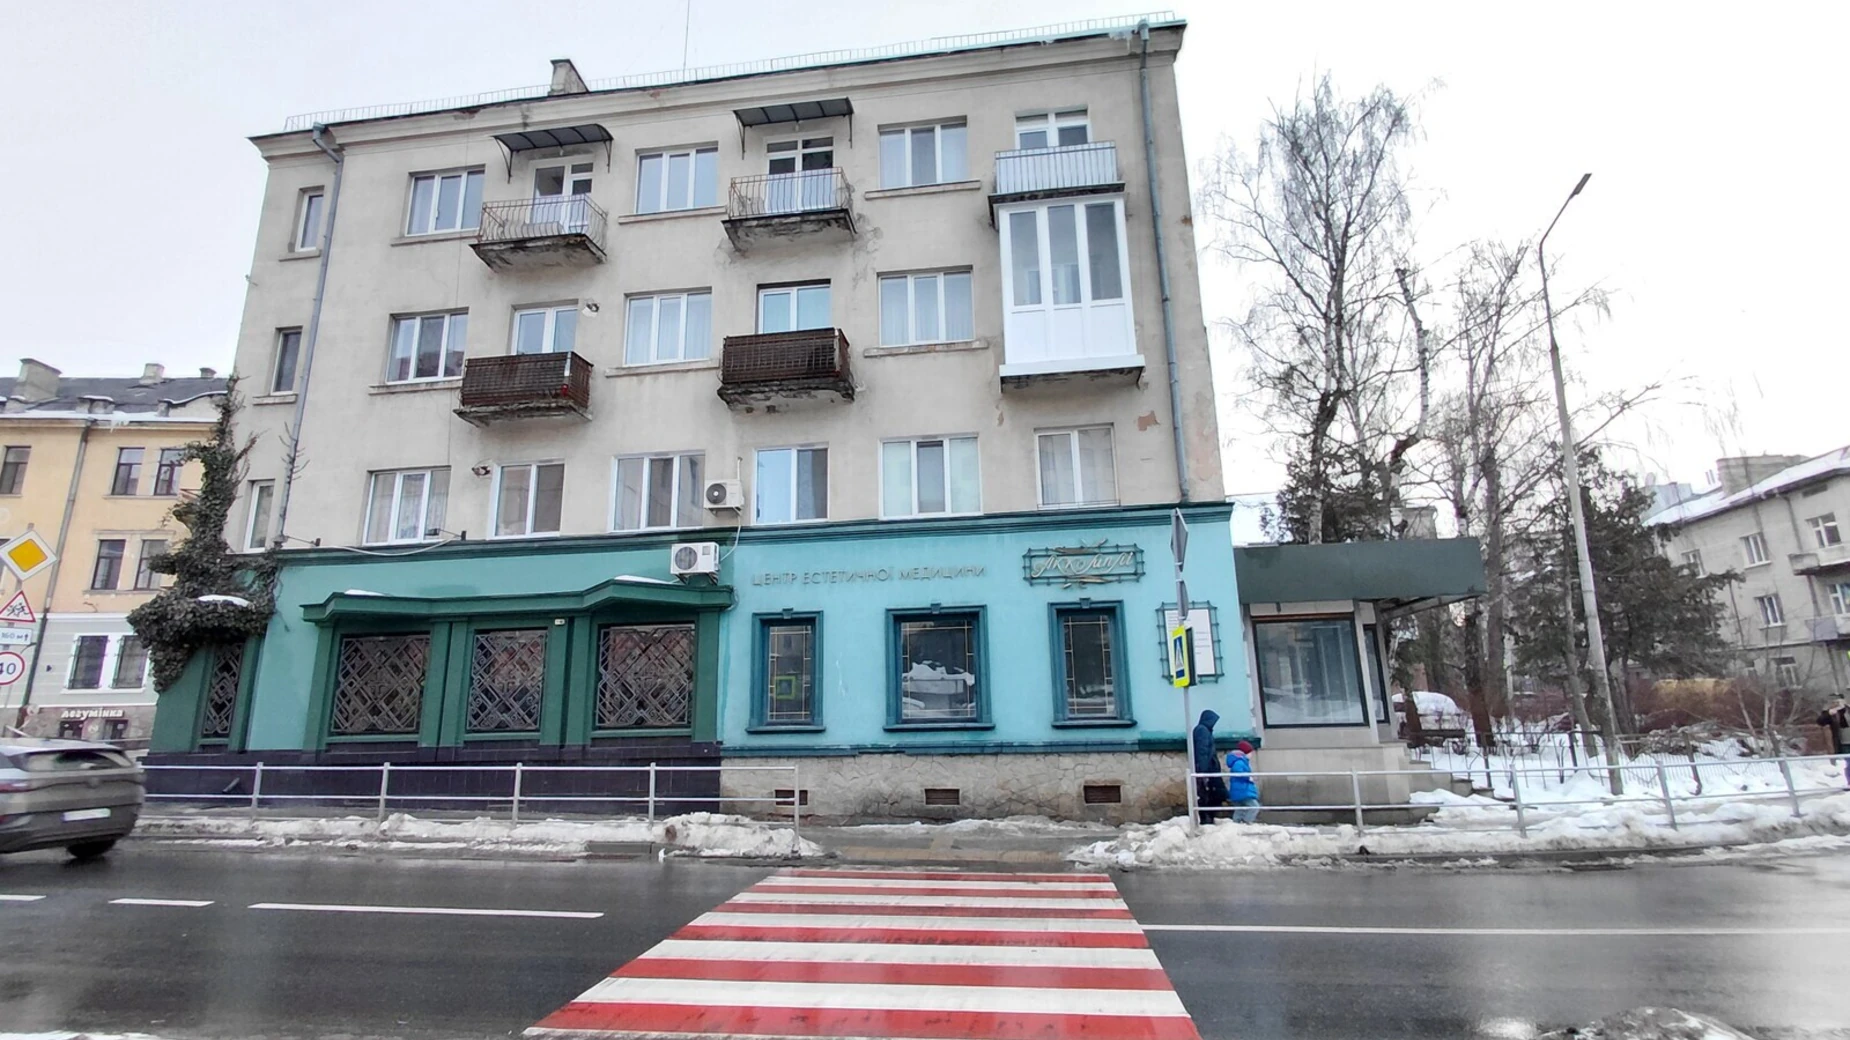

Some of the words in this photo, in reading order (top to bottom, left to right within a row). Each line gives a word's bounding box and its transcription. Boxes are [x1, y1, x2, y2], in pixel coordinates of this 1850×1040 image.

[751, 573, 798, 587] ЦЕНТР
[802, 566, 895, 585] ЕСТЕТИЧНОЇ
[899, 566, 986, 581] МЕДИЦИНИ
